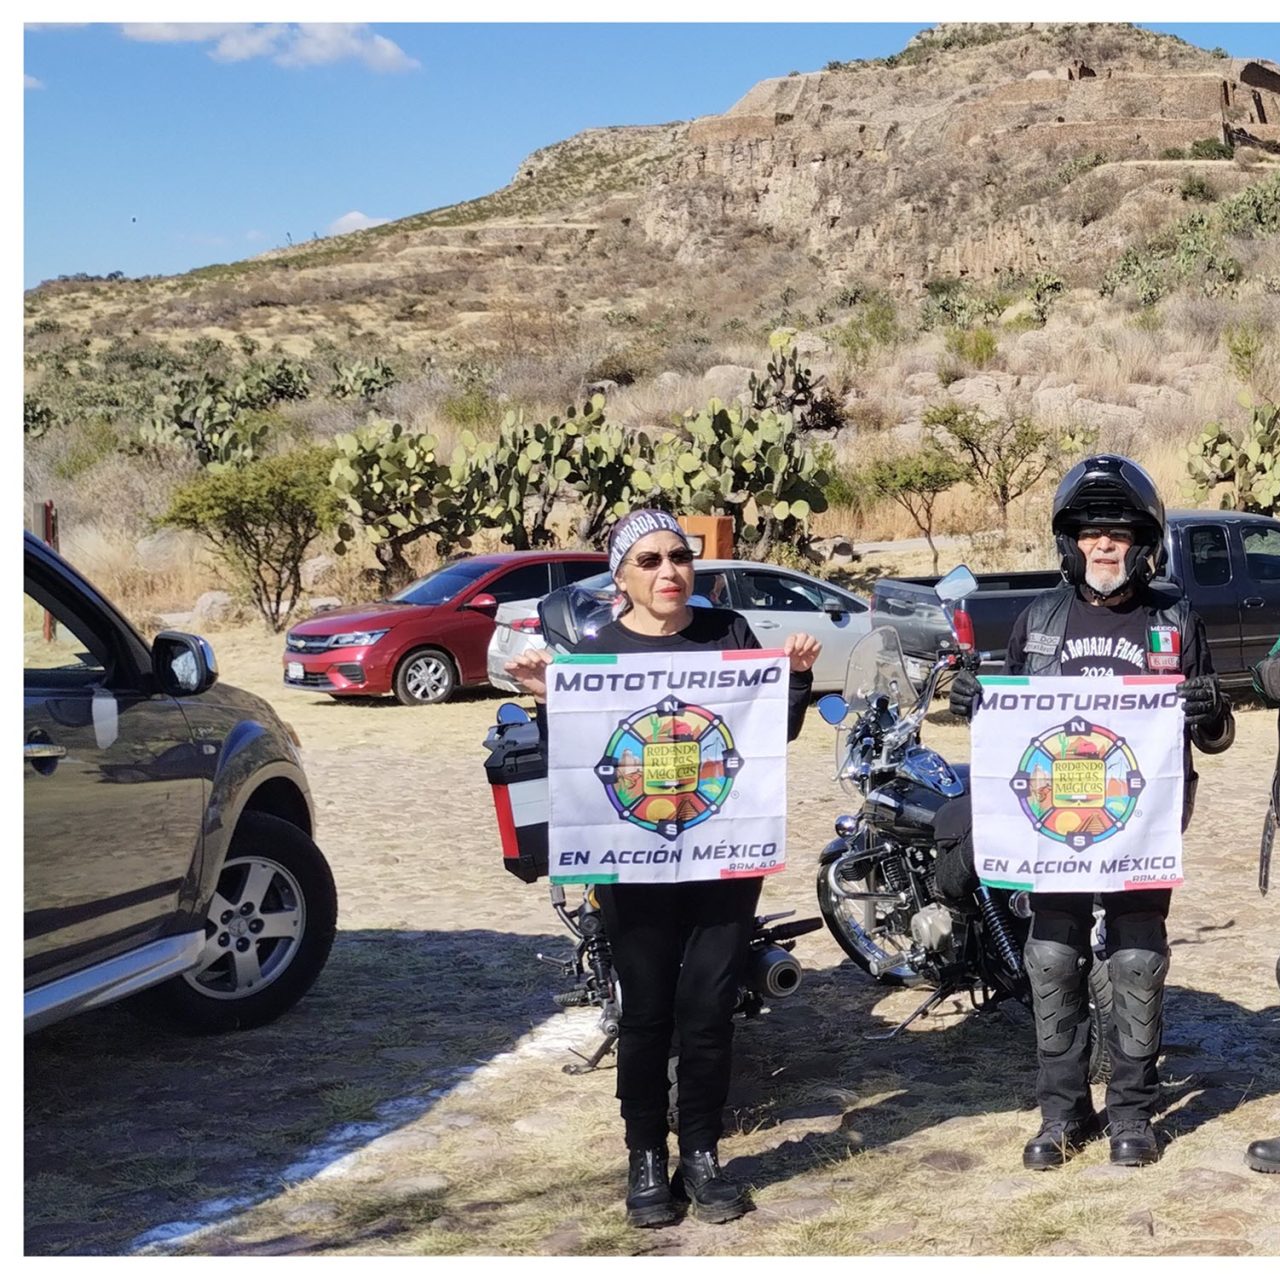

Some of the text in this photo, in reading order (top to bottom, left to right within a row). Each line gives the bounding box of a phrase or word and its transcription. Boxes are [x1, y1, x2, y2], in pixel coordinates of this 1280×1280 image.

[1080, 666, 1114, 677] 2024
[554, 666, 782, 692] MOTOTURISMO
[663, 701, 679, 712] N
[978, 692, 1179, 710] MOTOTURISMO
[1071, 721, 1085, 732] N
[726, 757, 739, 768] E
[598, 765, 614, 775] O
[1013, 779, 1027, 789] O
[1129, 778, 1142, 788] E
[666, 824, 678, 835] S
[1073, 835, 1086, 846] S
[558, 840, 777, 866] EN ACCIÓN MÉXICO
[982, 854, 1176, 874] EN ACCIÓN MÉXICO
